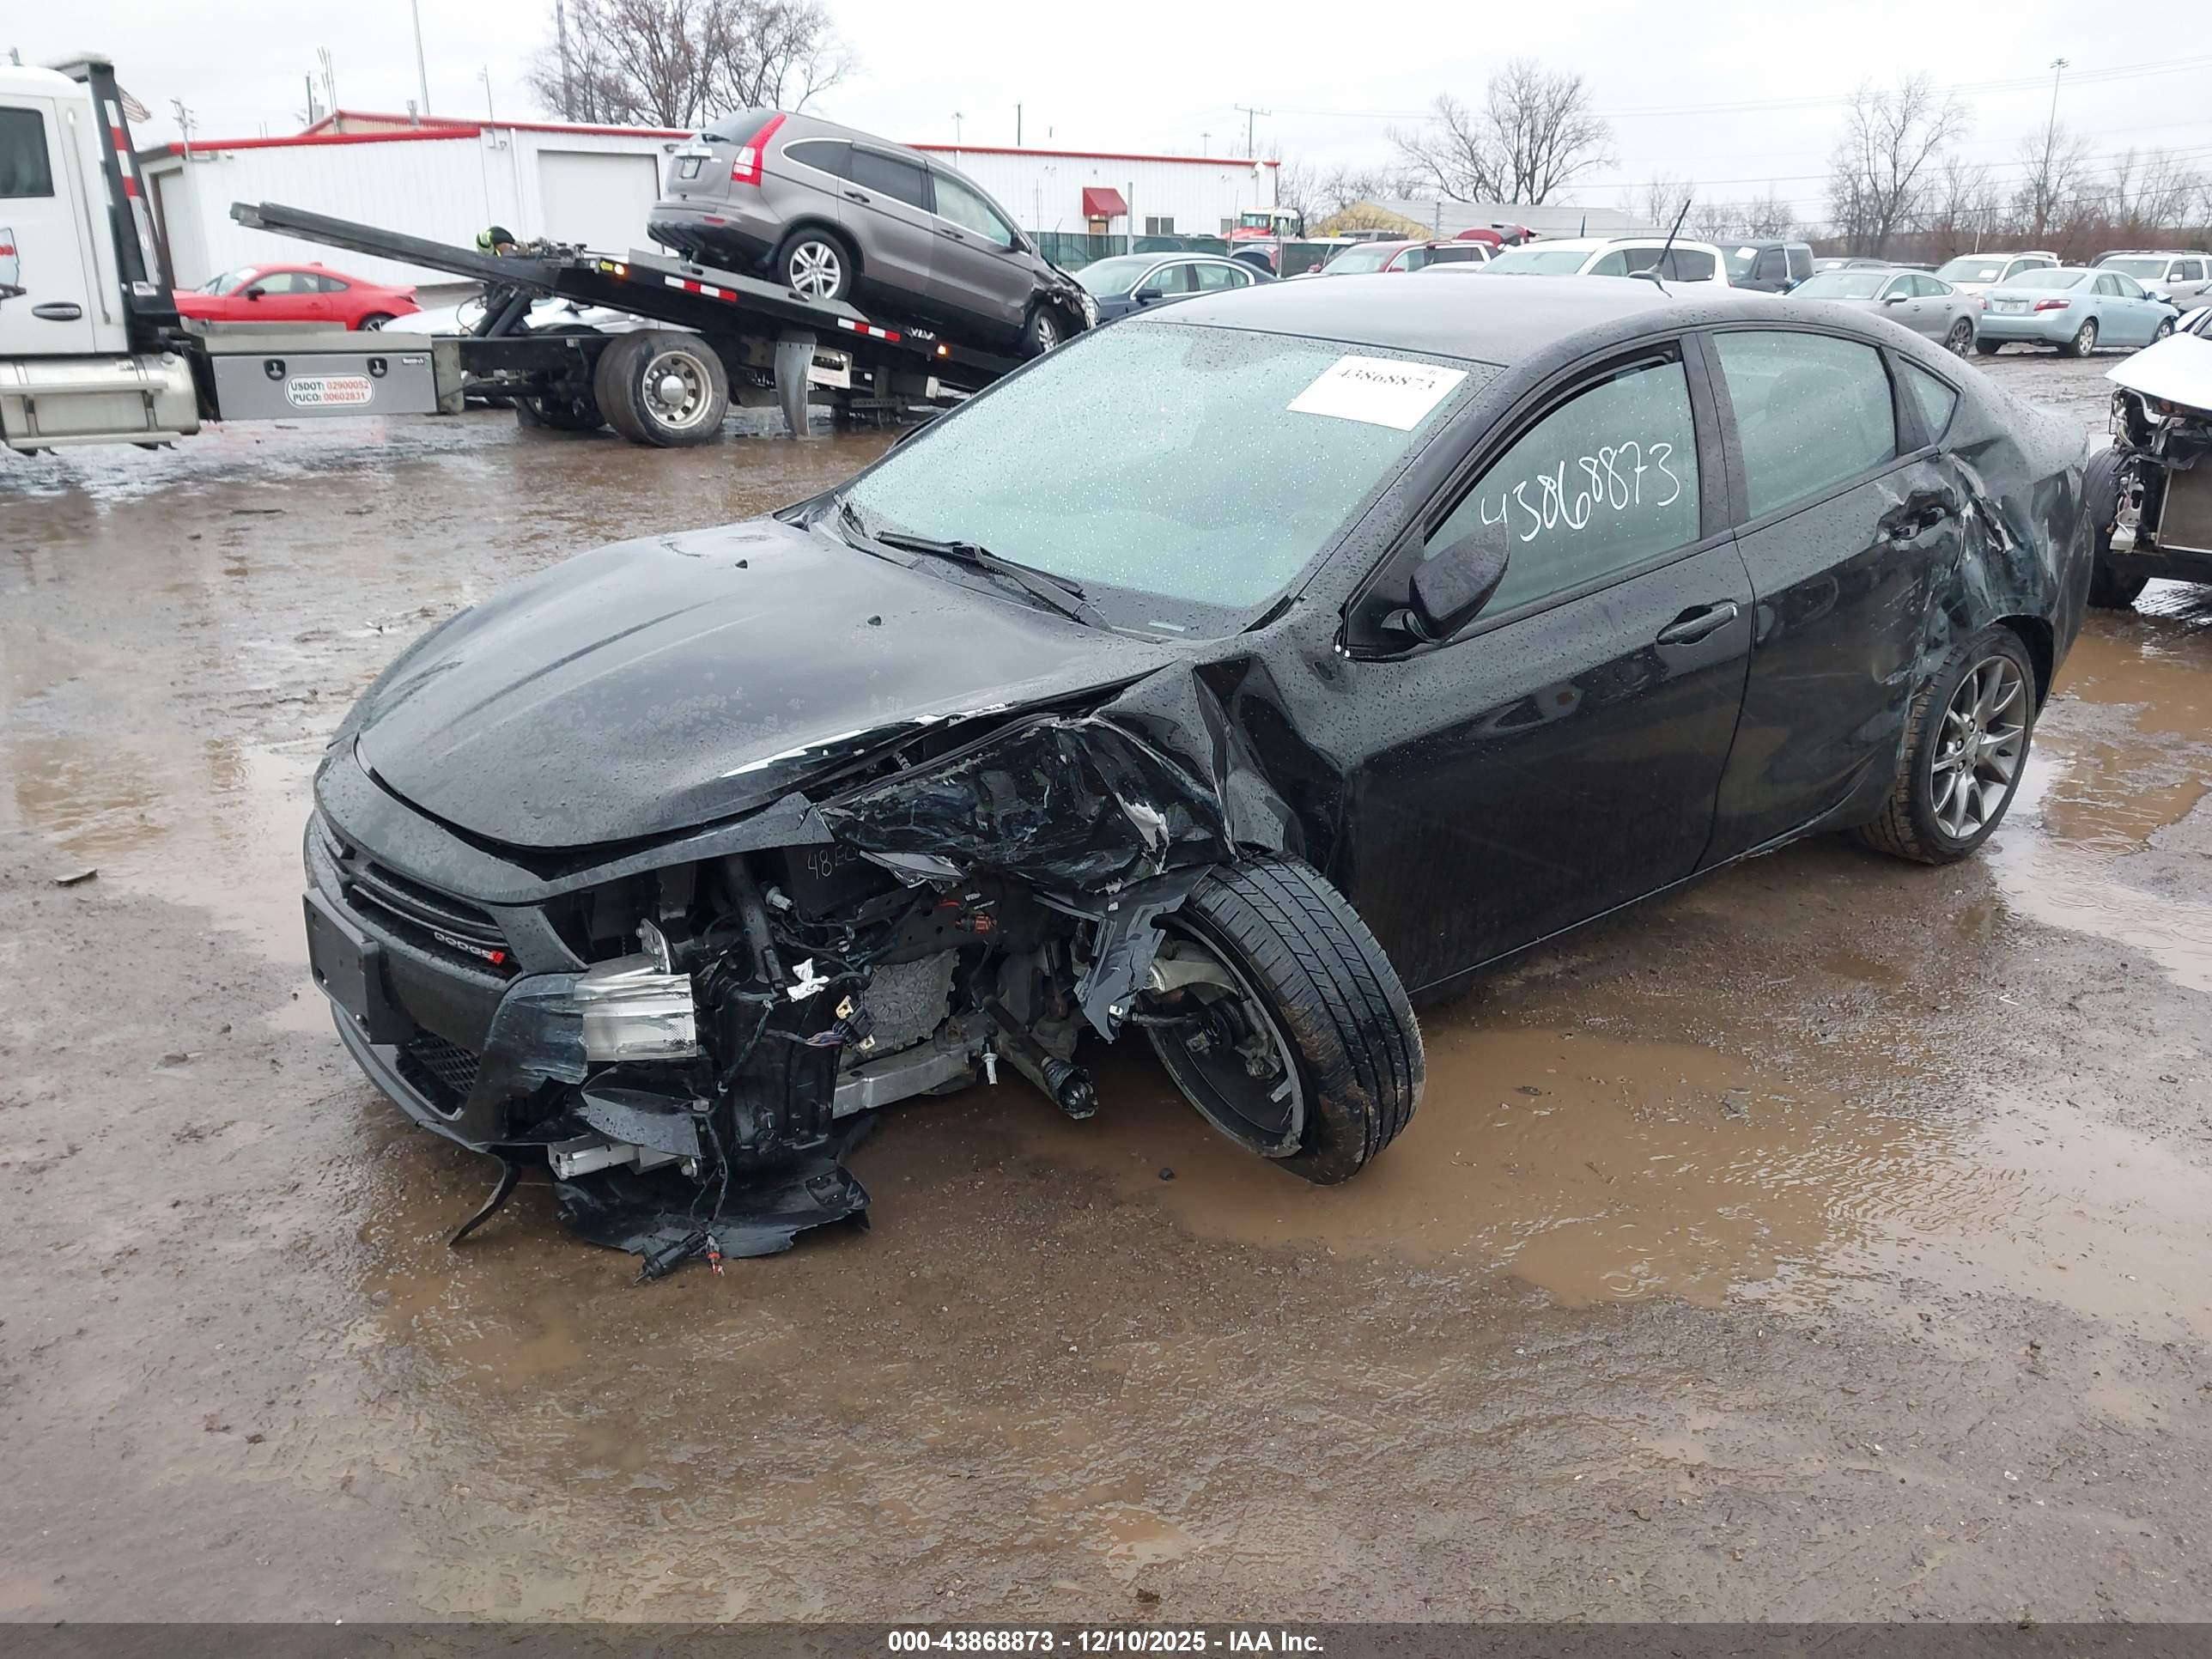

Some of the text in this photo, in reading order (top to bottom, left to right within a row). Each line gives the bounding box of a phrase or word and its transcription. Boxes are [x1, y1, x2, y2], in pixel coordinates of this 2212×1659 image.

[290, 380, 369, 392] USDOT: 02900052
[293, 392, 366, 402] PUCO: 00602831
[1480, 441, 1680, 542] 43868873
[807, 848, 833, 880] 48
[434, 931, 495, 961] DODGE
